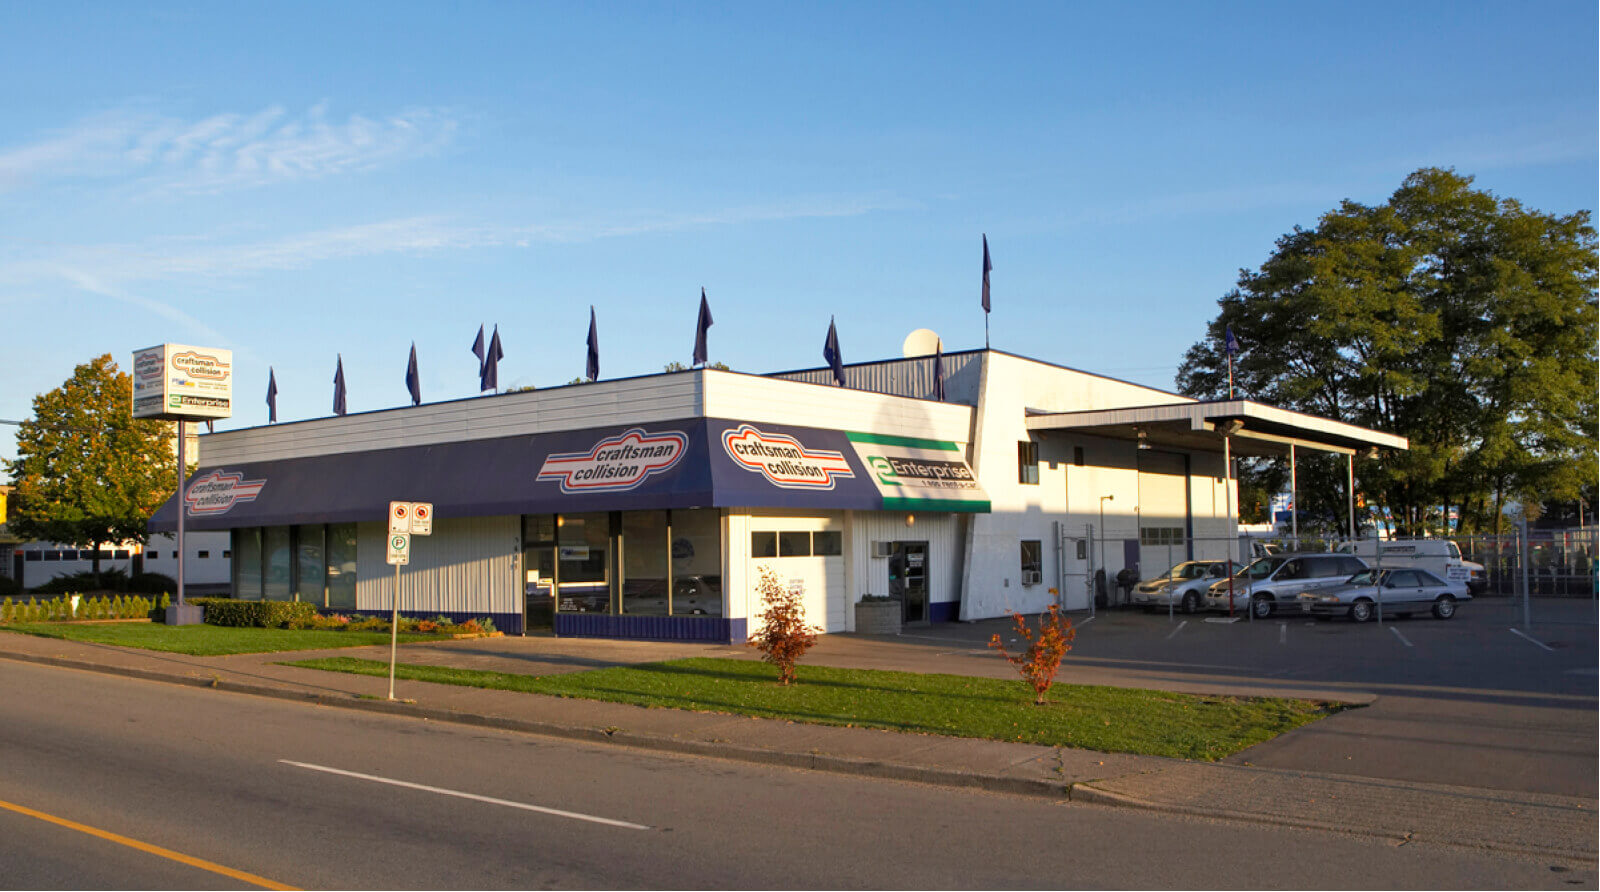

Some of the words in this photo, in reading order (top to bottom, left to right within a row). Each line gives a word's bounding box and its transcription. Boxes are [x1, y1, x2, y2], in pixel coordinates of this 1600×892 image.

[596, 444, 674, 462] craftsman
[733, 441, 802, 460] craftsman
[574, 462, 639, 481] collision
[767, 460, 823, 477] collision
[890, 460, 972, 480] Enterprise
[192, 482, 233, 493] craftsman
[197, 494, 233, 505] collision
